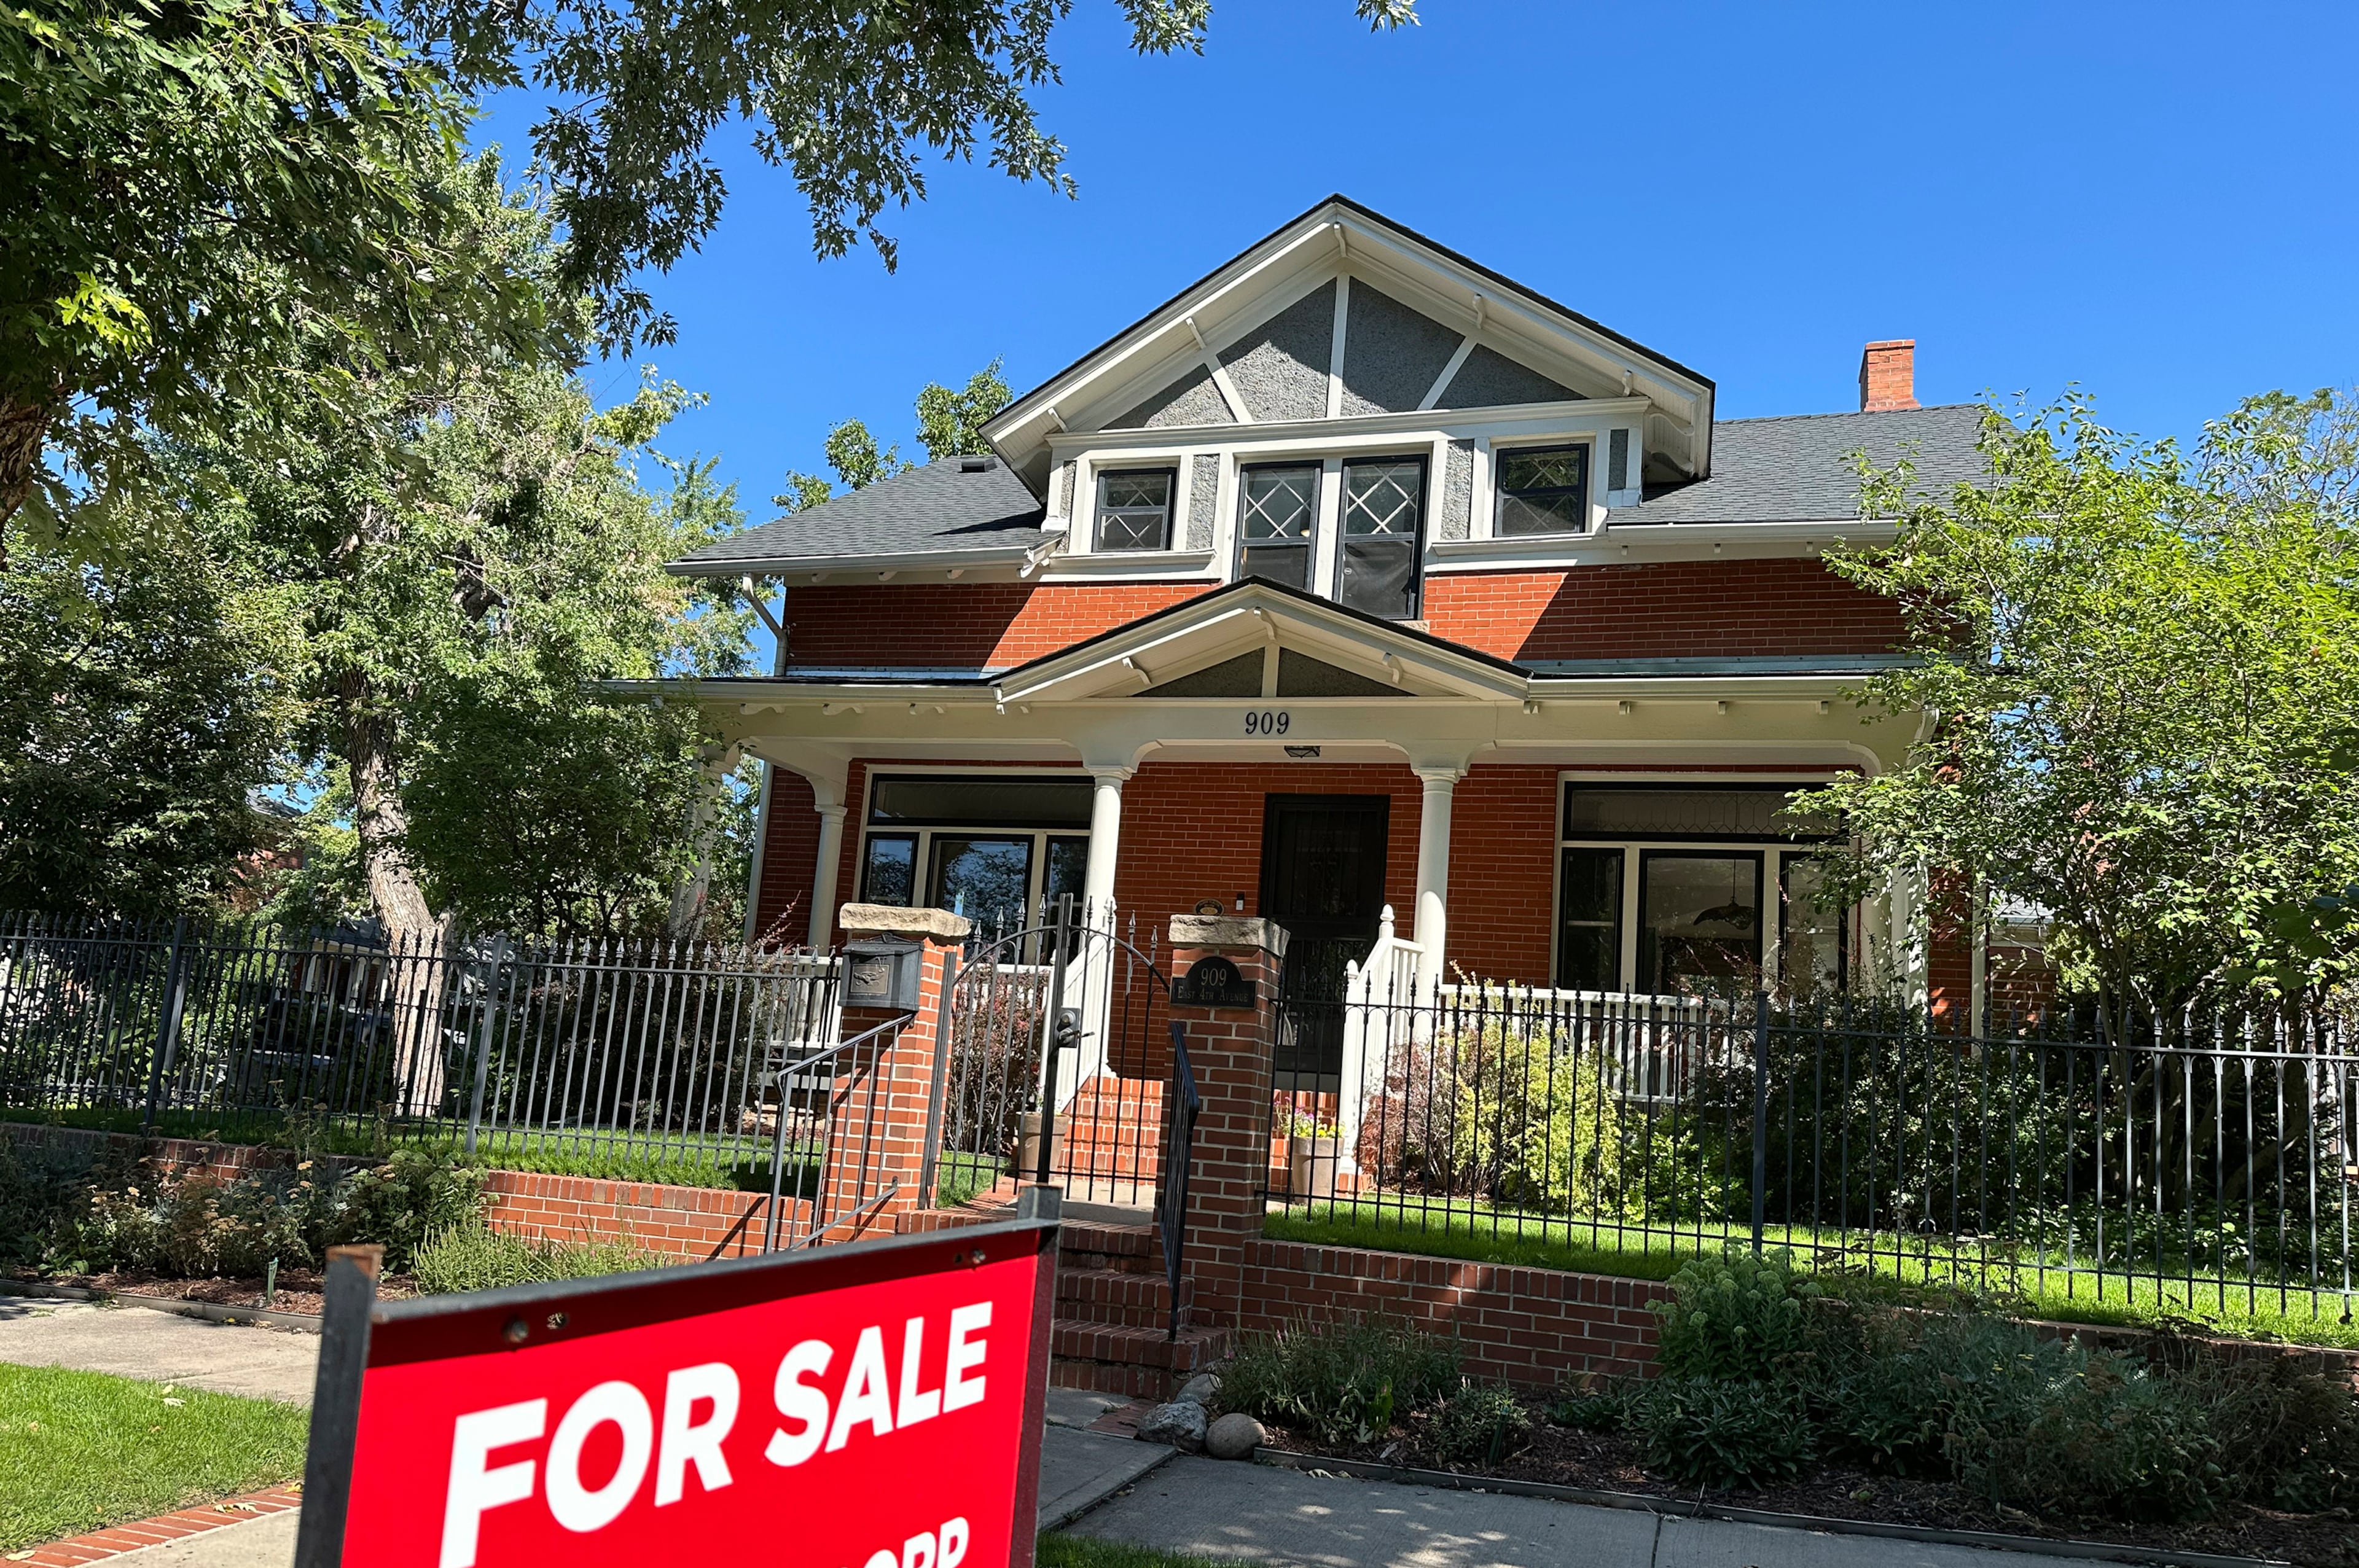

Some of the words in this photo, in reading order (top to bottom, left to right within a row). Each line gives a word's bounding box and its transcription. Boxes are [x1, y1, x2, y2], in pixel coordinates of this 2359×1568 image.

[1245, 712, 1289, 735] 909
[1201, 968, 1227, 986] 909
[439, 1362, 740, 1568] FOR
[764, 1301, 993, 1467] SALE
